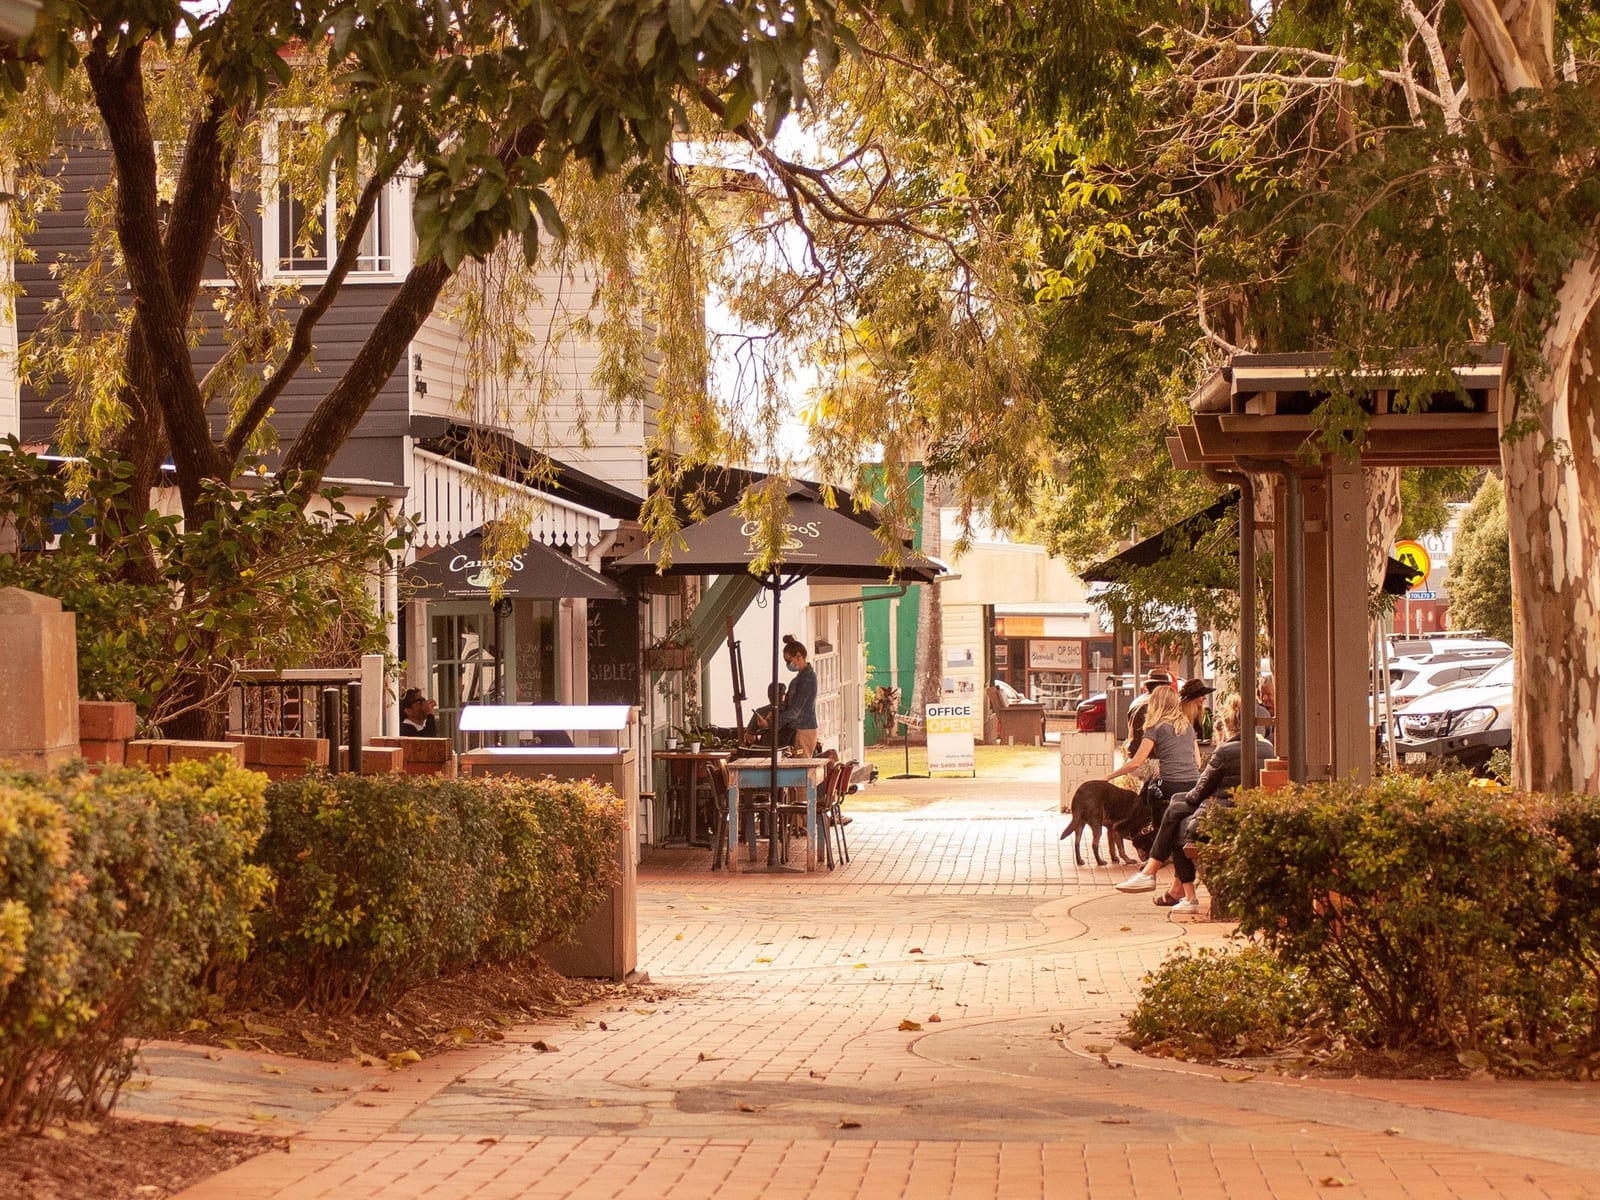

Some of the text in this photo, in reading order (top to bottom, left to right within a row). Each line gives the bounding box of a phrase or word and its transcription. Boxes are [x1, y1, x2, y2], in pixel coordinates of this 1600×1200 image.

[1057, 645, 1066, 656] OP
[928, 706, 971, 716] OFFICE
[929, 719, 971, 732] OPEN
[1061, 753, 1110, 766] COFFEE
